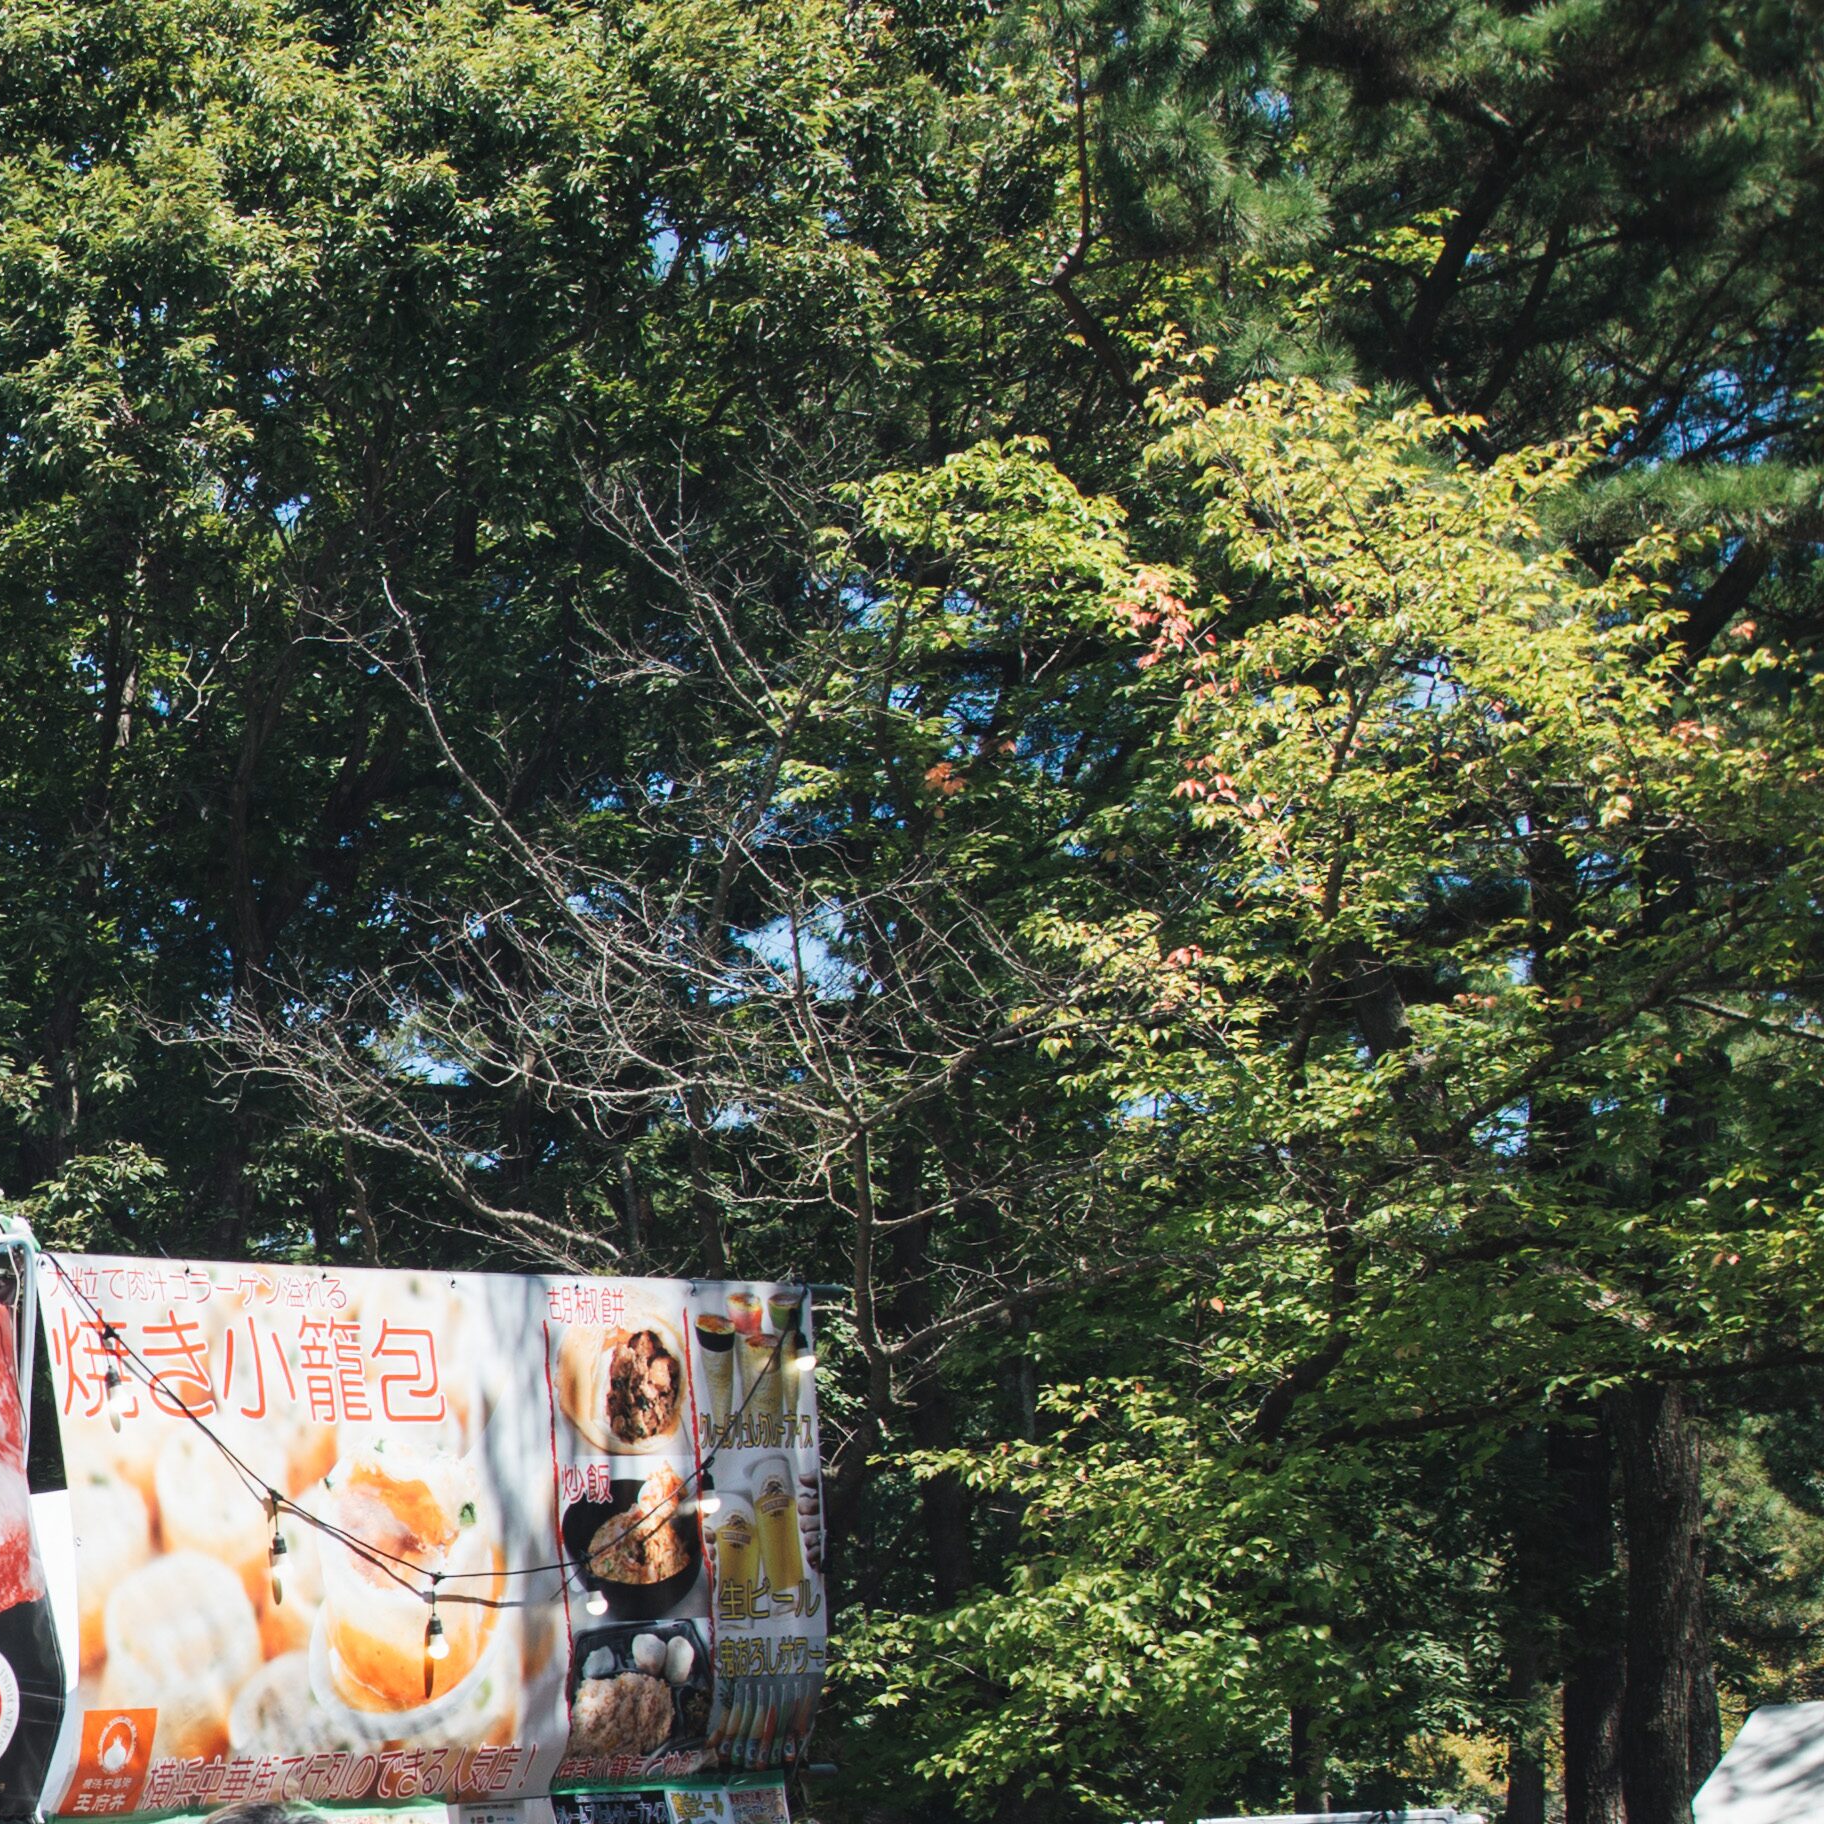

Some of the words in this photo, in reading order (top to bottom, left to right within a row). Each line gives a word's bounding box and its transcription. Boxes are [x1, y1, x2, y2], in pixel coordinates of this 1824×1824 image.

[46, 1266, 348, 1310] 大粒で肉汁コラーゲン溢れる
[50, 1306, 446, 1424] 焼き小籠包
[560, 1463, 614, 1504] 炒飯
[718, 1576, 822, 1621] 生ビール
[718, 1635, 825, 1680] 鬼おろしサワー
[72, 1793, 127, 1812] 王府井
